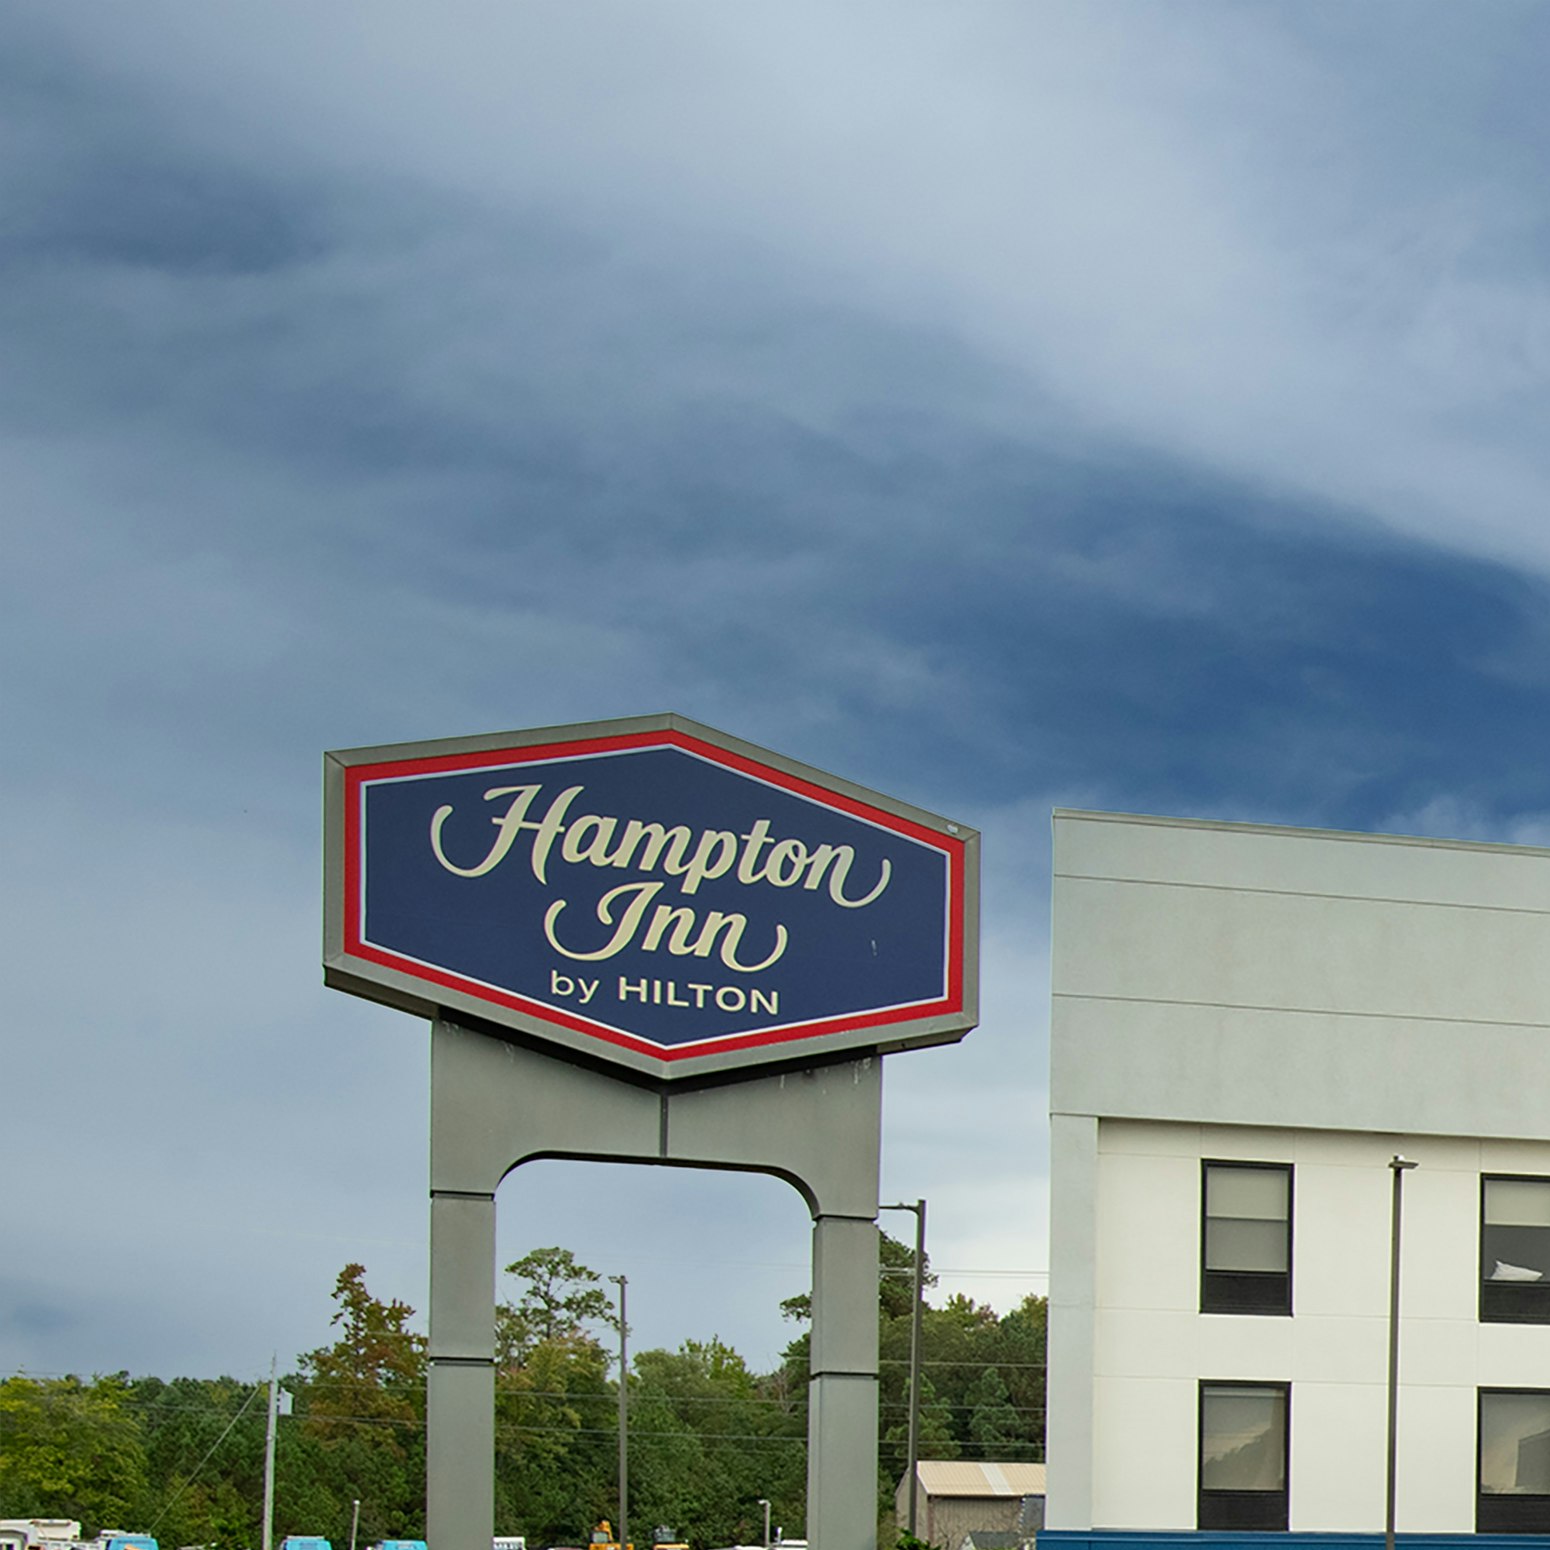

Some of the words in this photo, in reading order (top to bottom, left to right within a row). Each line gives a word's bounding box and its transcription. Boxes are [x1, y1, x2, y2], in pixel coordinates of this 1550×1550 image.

[431, 785, 891, 908] Hampton
[544, 881, 788, 972] Inn
[551, 969, 600, 1004] by
[618, 976, 779, 1015] HILTON
